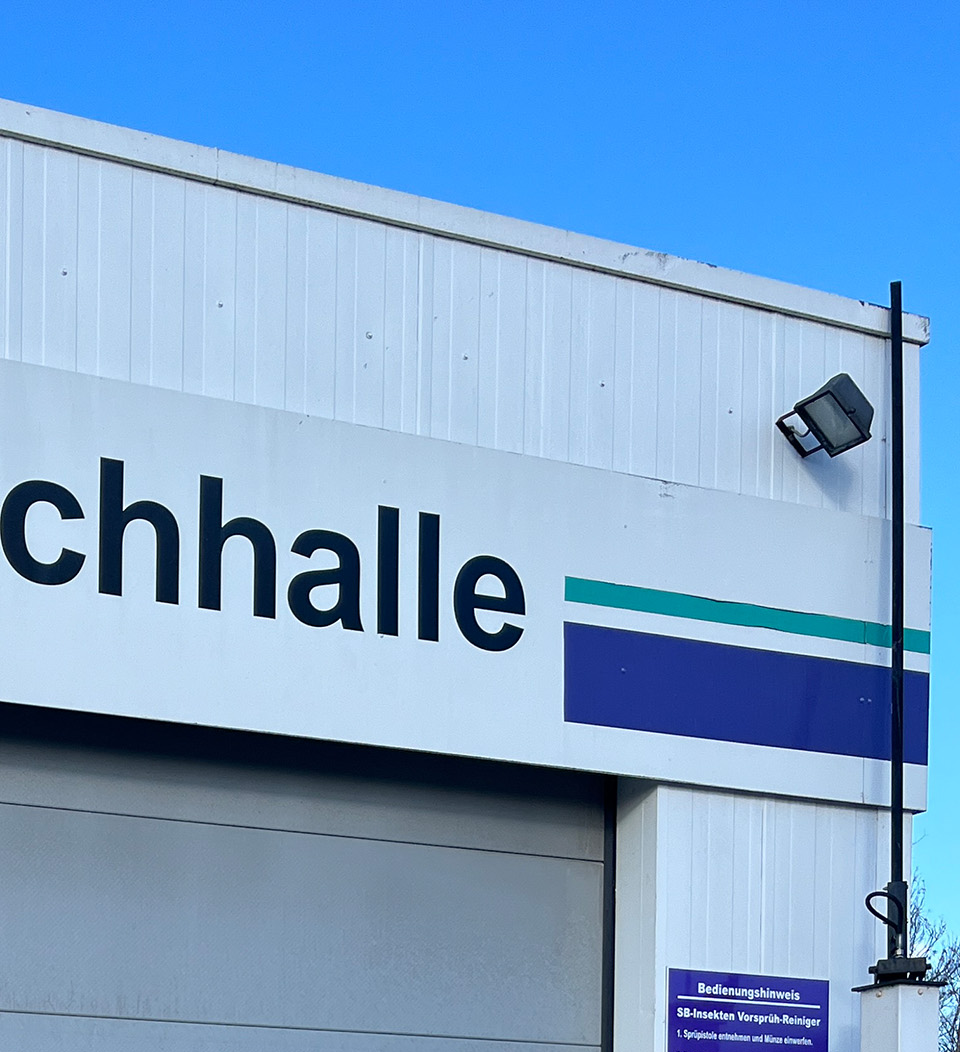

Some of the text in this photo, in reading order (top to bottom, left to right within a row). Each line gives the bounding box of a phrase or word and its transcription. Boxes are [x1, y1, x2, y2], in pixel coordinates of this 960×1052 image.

[697, 982, 801, 1001] Bedienungshinweis
[676, 1007, 821, 1029] SB-Insekten Vorsprüh-Reiniger
[676, 1029, 683, 1038] 1.
[718, 1032, 751, 1043] entnehmen
[751, 1034, 764, 1043] und
[764, 1034, 783, 1045] Münze
[783, 1036, 814, 1046] einwerfen.
